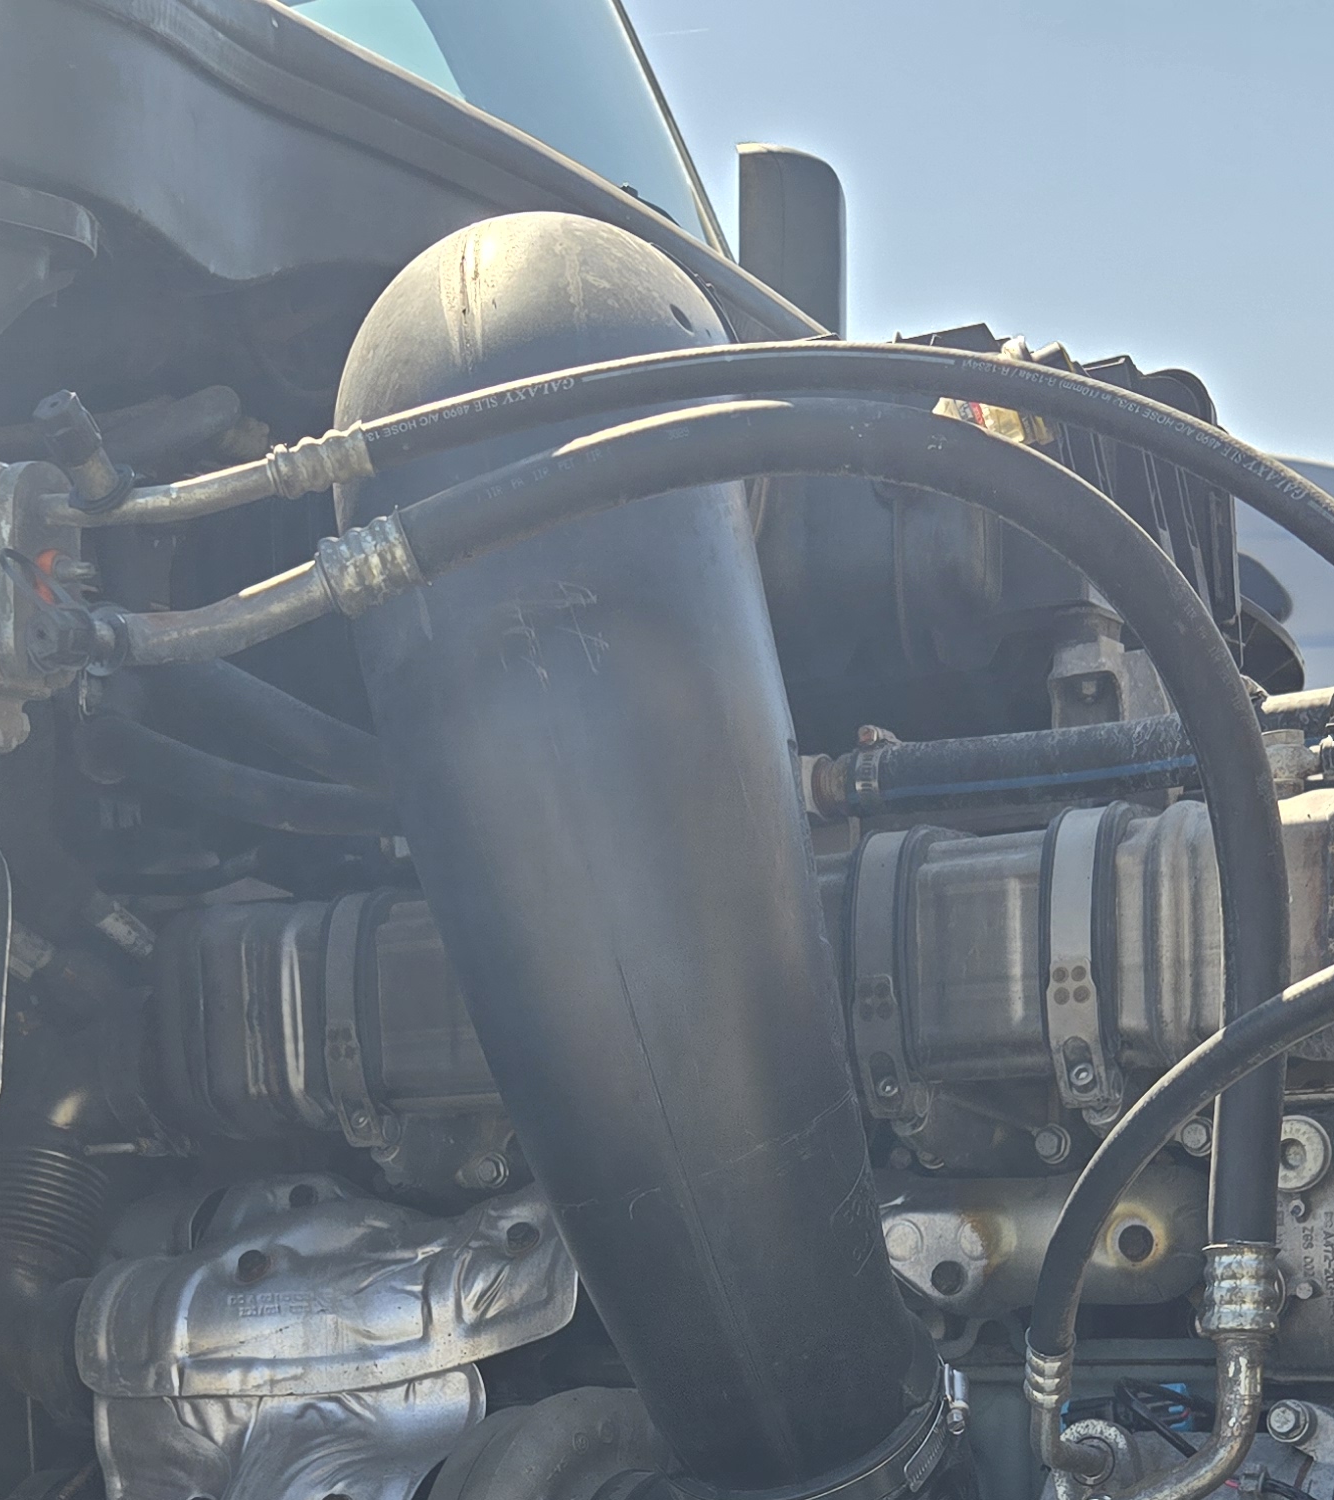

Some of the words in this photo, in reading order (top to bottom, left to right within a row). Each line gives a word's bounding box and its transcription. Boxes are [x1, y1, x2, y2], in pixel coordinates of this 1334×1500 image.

[503, 376, 575, 404] GALAXY
[475, 395, 499, 413] SLE
[419, 412, 439, 428] A/C
[1142, 406, 1174, 428] HOSE
[383, 421, 417, 438] HOSE
[1243, 457, 1309, 501] GALAXY
